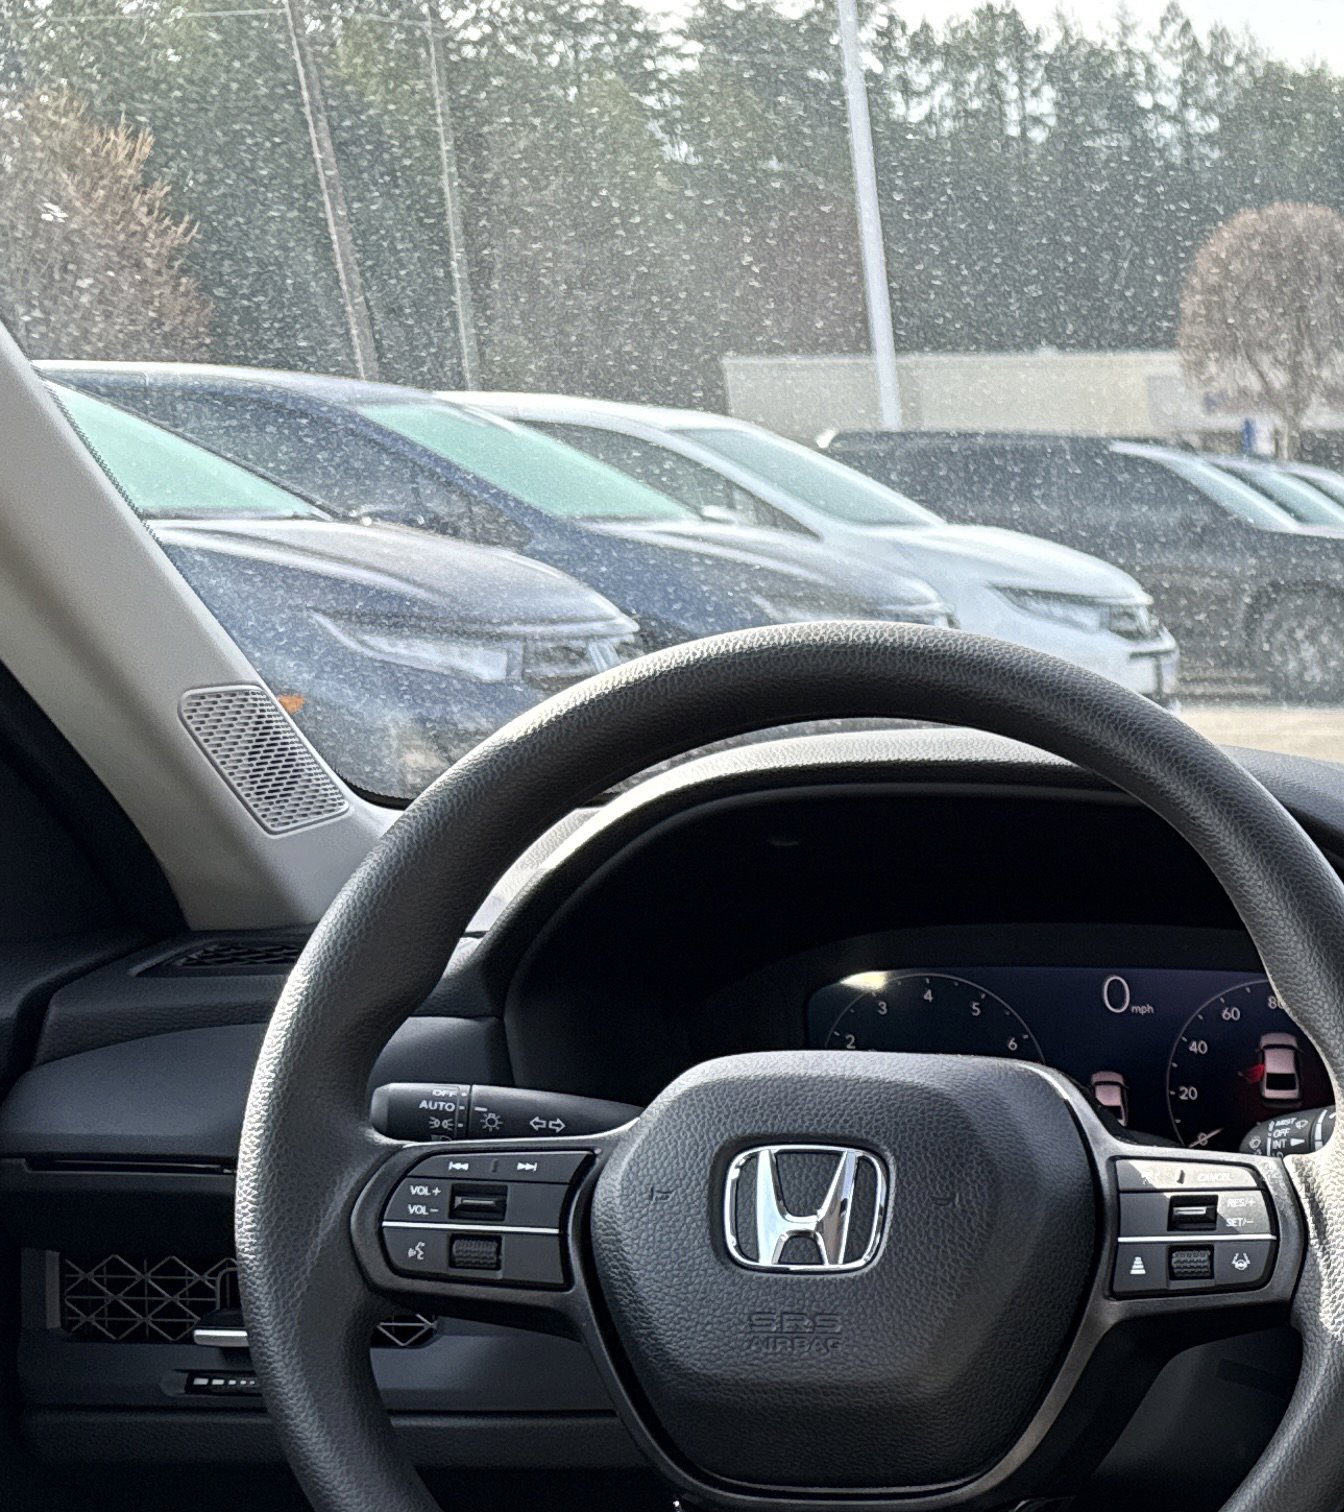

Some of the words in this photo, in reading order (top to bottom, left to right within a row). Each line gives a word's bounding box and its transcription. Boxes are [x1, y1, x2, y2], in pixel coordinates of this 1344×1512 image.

[923, 988, 934, 1003] 4
[1103, 975, 1131, 1014] 0
[1131, 1004, 1154, 1016] mph
[877, 1001, 889, 1016] 3
[970, 1001, 982, 1017] 5
[1221, 1007, 1241, 1022] 60
[844, 1034, 857, 1050] 2
[1007, 1037, 1019, 1051] 6
[1188, 1040, 1209, 1055] 40
[1178, 1086, 1199, 1101] 20
[419, 1100, 456, 1112] AUTO
[1272, 1128, 1291, 1138] OFF
[1272, 1139, 1288, 1150] INT
